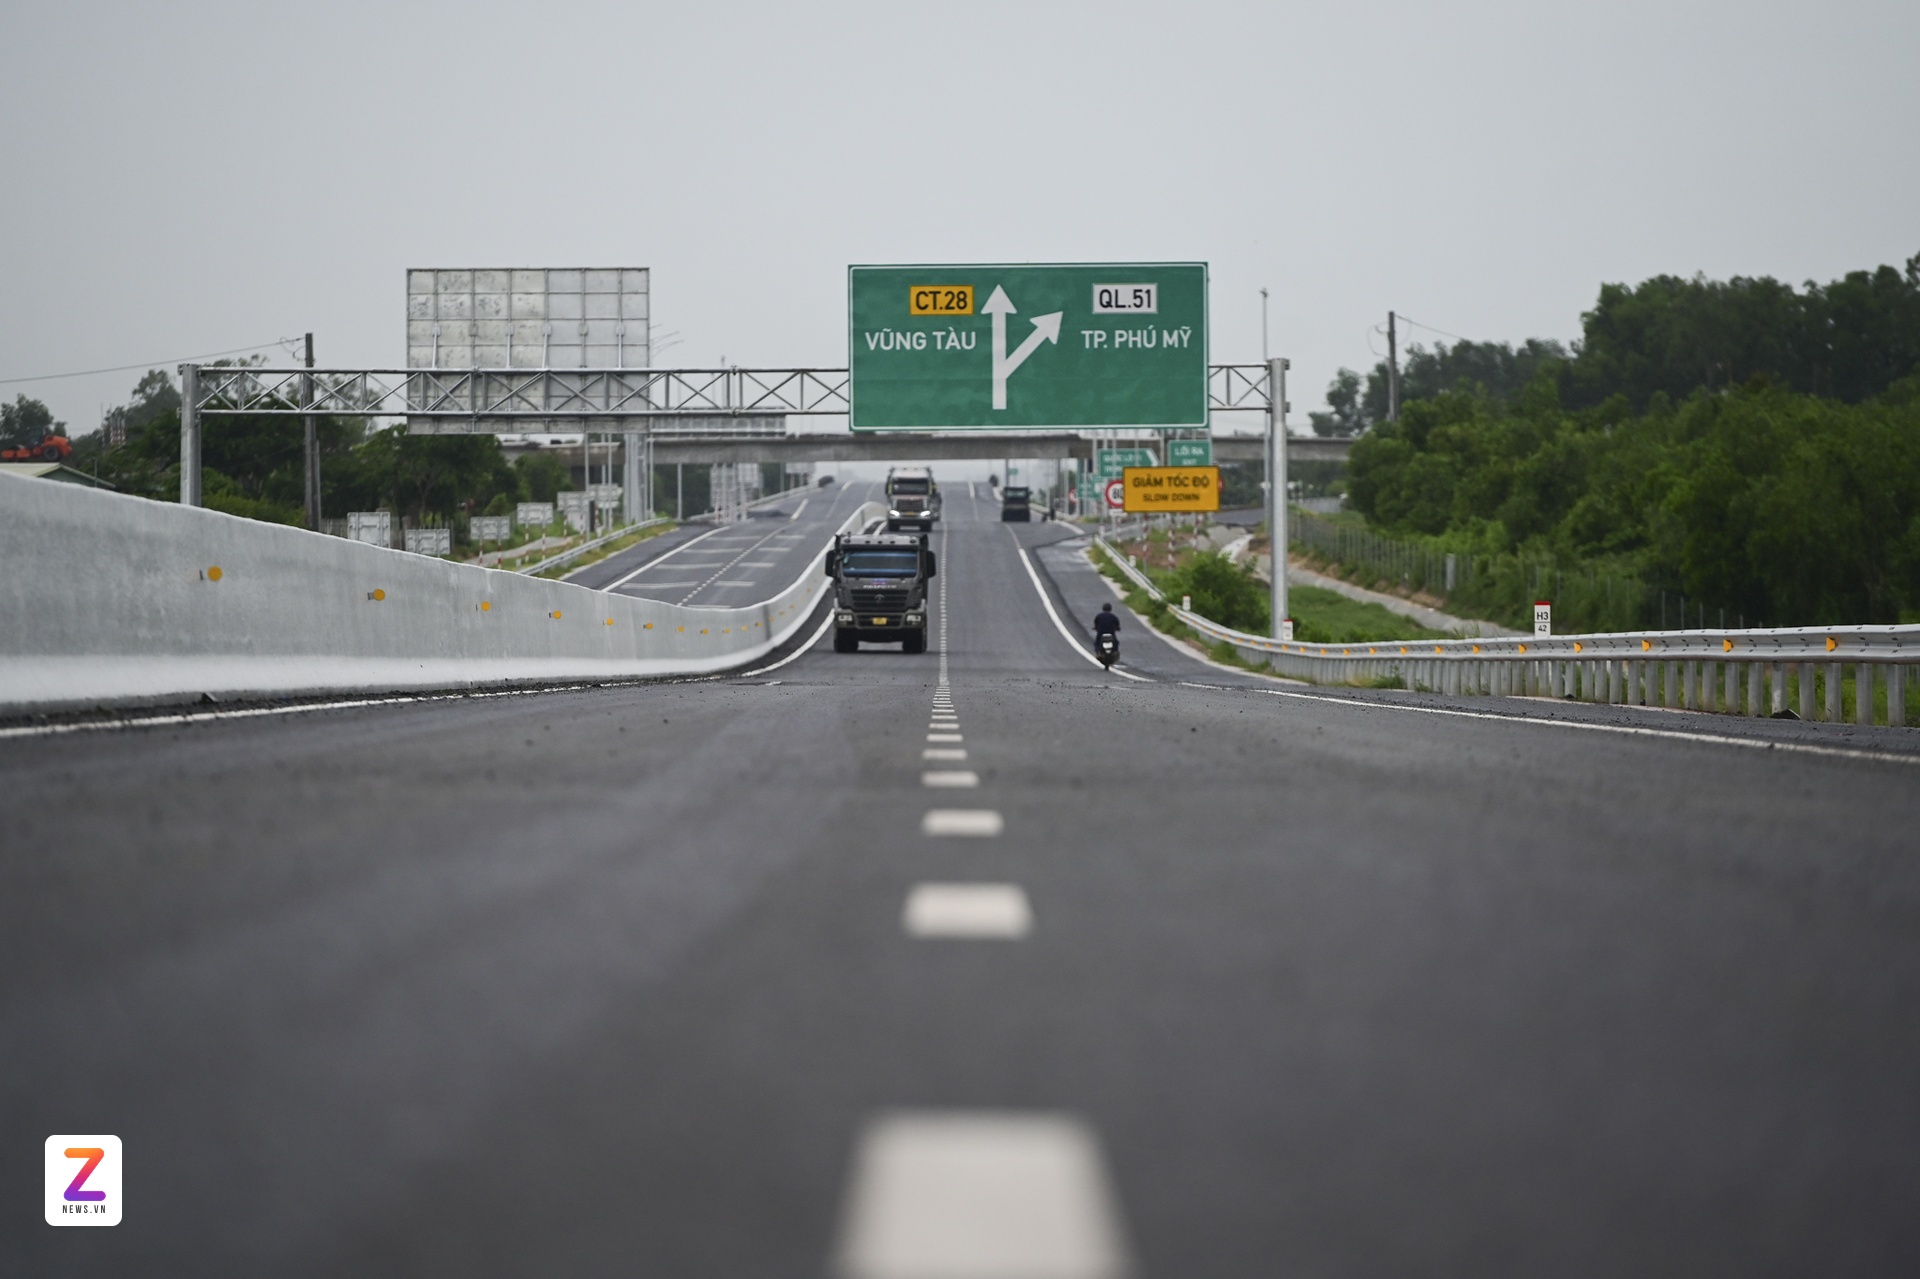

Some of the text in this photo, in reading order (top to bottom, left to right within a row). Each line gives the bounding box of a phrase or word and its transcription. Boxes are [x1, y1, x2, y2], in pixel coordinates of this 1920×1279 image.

[916, 291, 968, 311] CT.28
[1099, 289, 1151, 308] QL.51
[865, 326, 976, 351] VŨNG TÀU
[1081, 325, 1192, 349] TP. PHÚ MỸ
[1132, 473, 1210, 489] GIẢM TỐC ĐỘ
[1143, 493, 1200, 502] SLOW DOWN
[1537, 612, 1549, 620] H3
